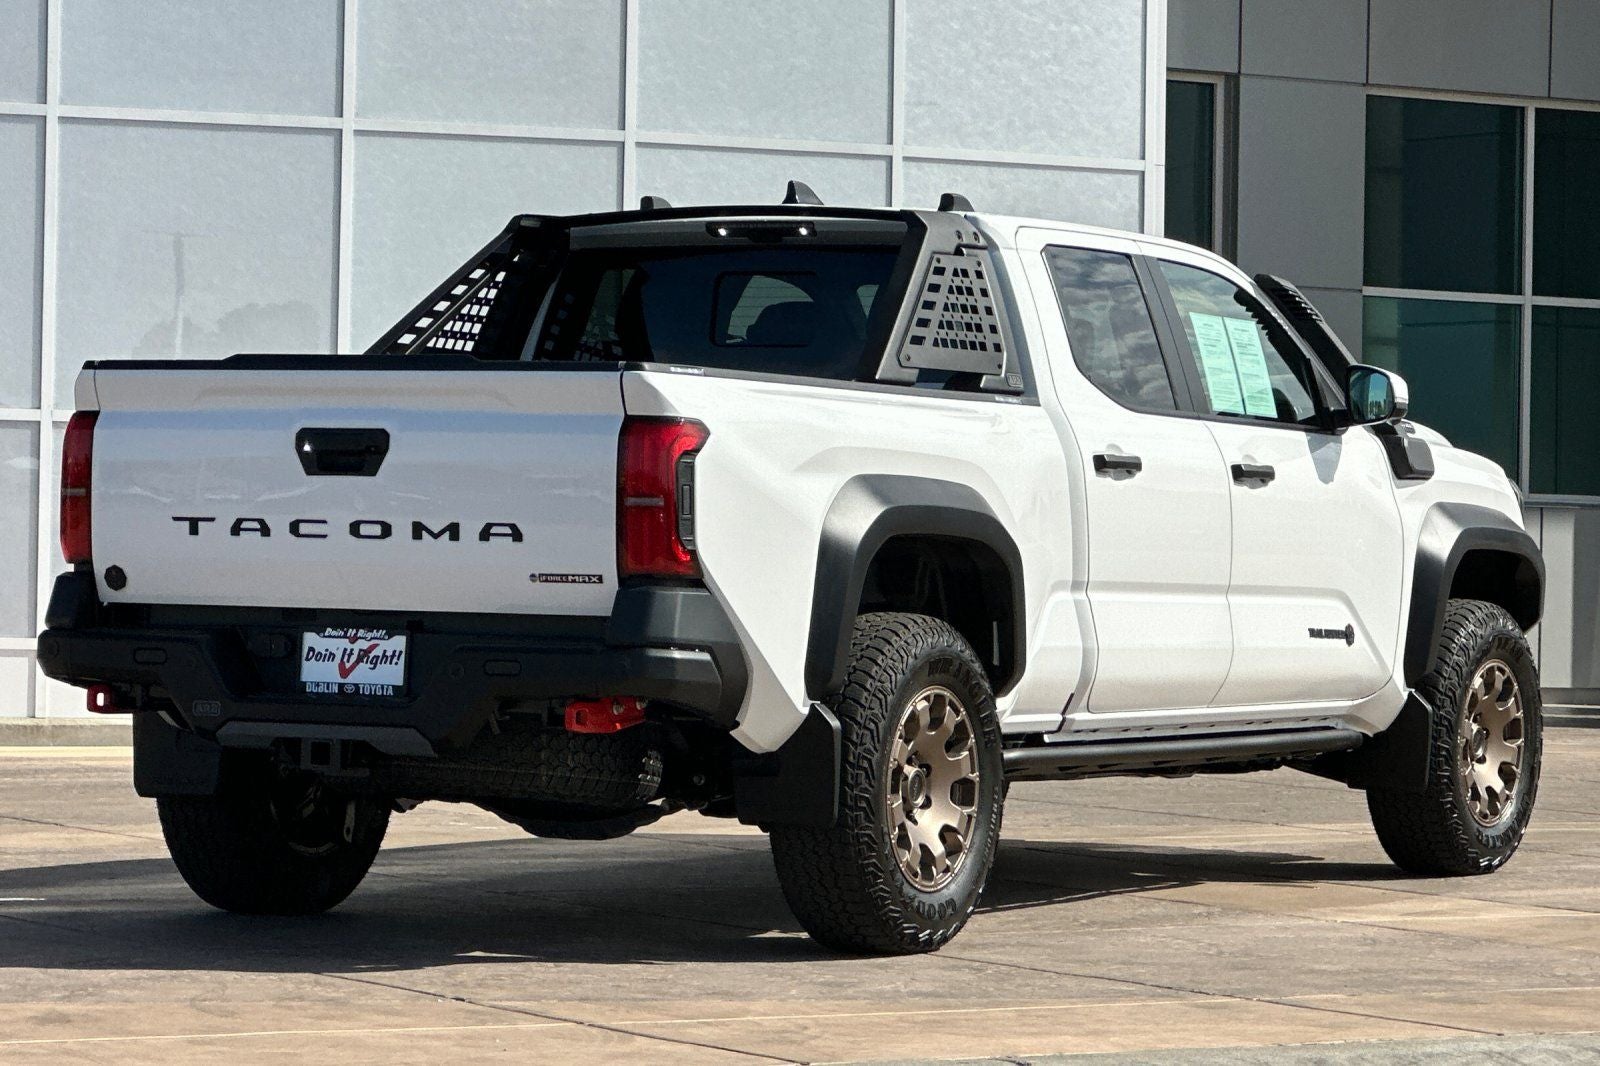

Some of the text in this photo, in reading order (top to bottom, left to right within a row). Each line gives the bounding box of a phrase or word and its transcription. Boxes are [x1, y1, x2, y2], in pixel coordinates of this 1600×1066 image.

[171, 516, 523, 542] TACOMA
[358, 629, 386, 641] Right!
[305, 646, 339, 662] Doin'
[341, 648, 354, 663] It
[305, 682, 394, 696] DUBLIN TOYOTA
